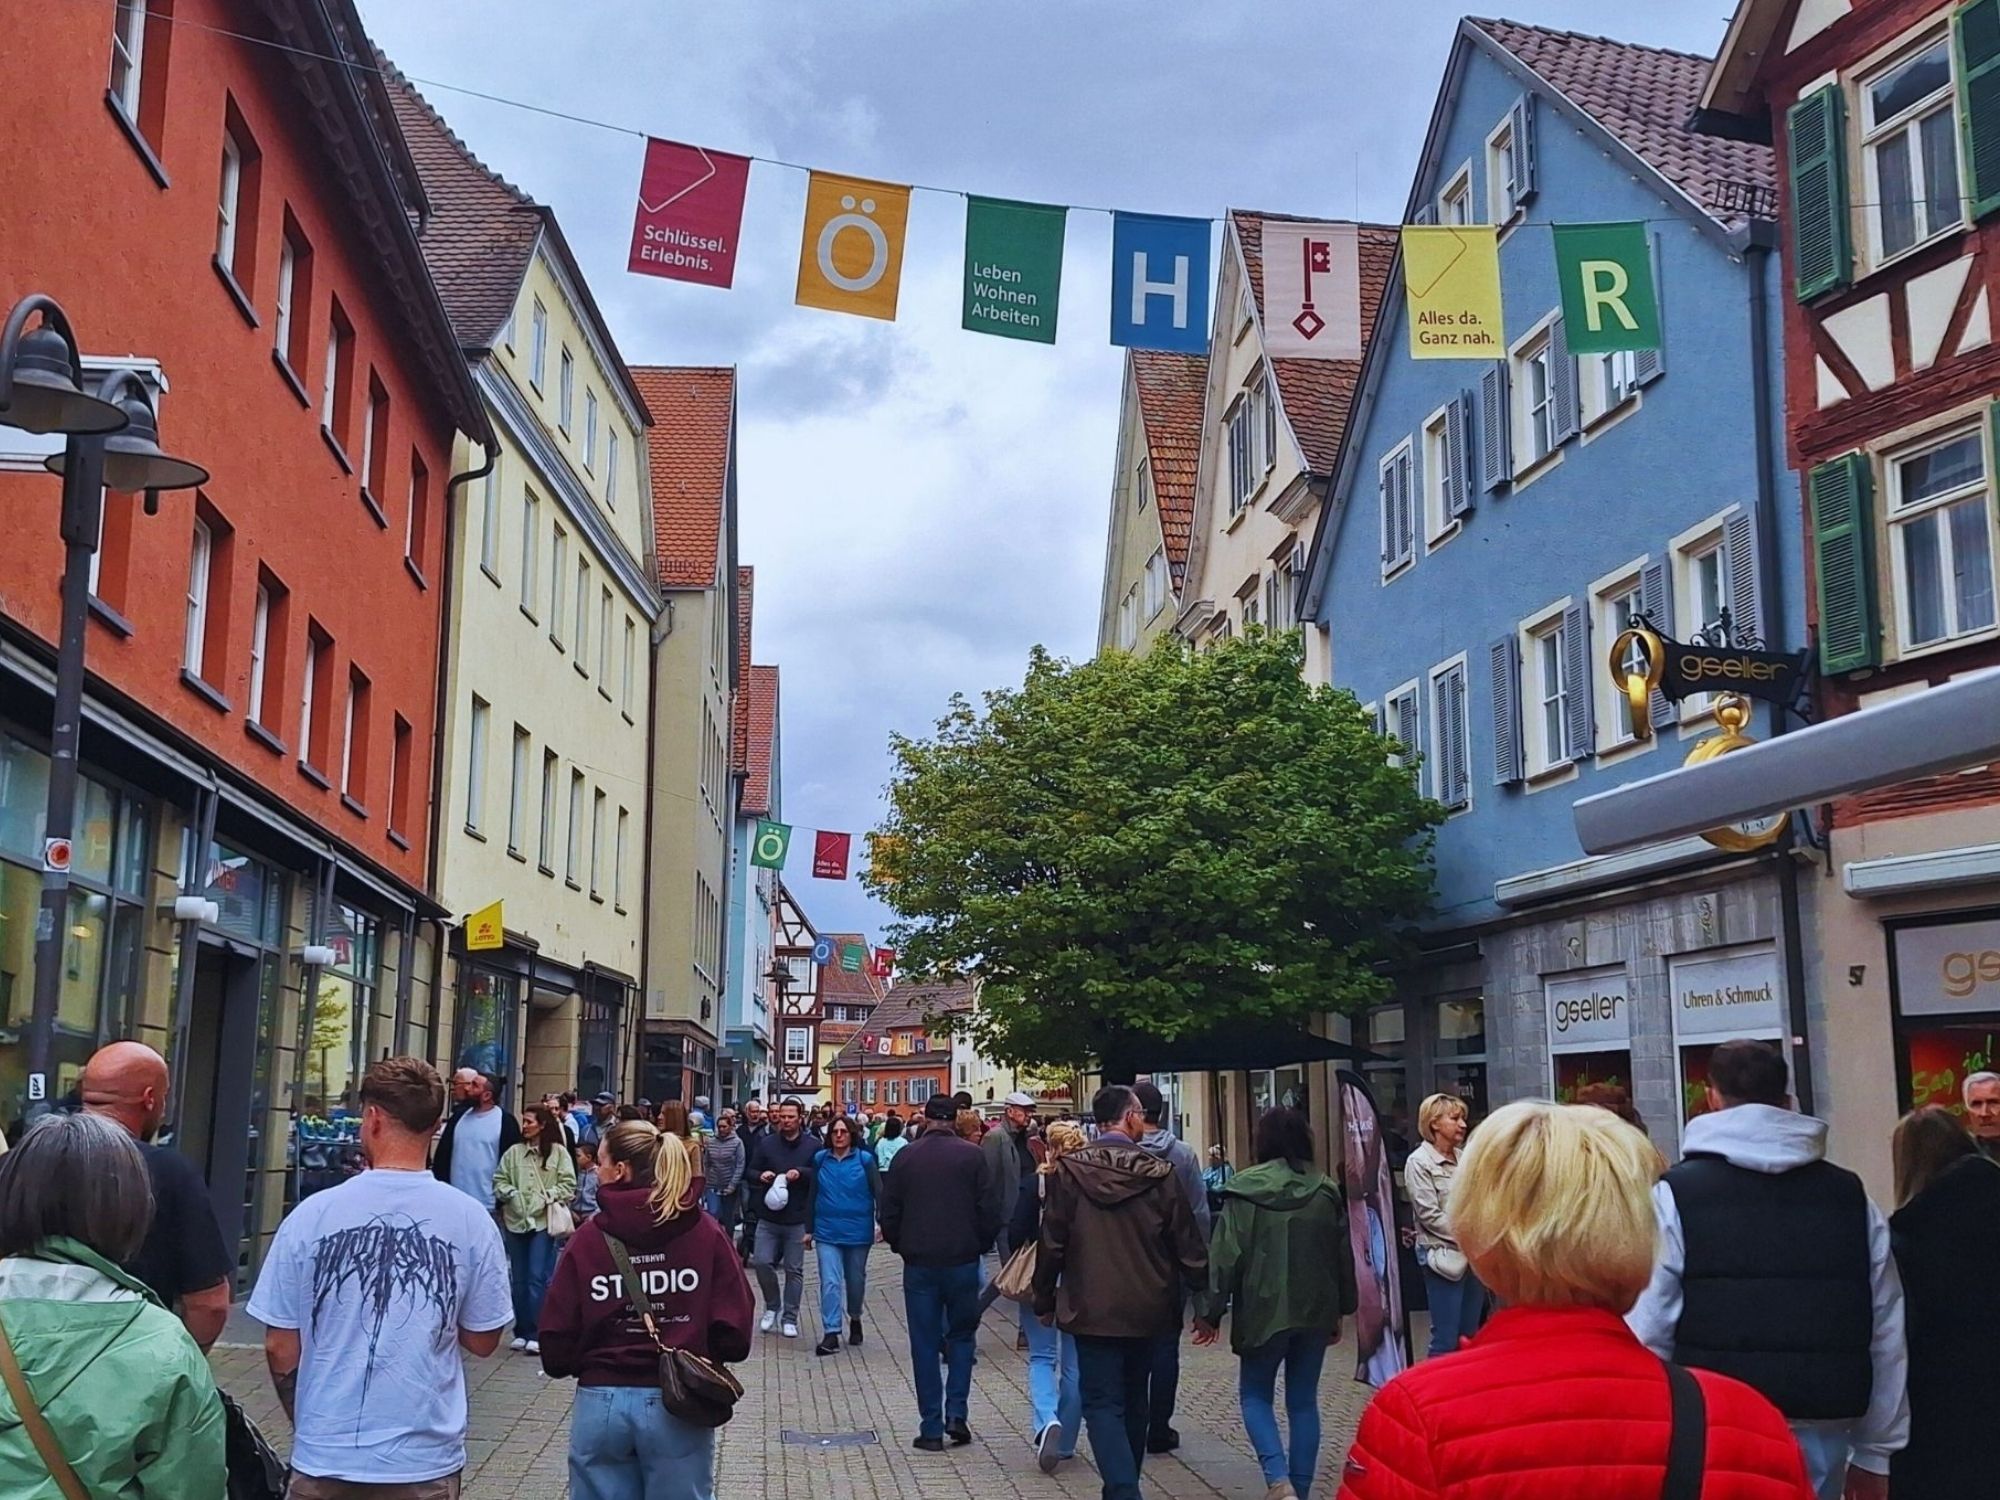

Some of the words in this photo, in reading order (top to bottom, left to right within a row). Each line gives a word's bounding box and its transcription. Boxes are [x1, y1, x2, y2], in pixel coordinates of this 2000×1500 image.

[644, 225, 727, 253] Schlüssel.
[817, 195, 889, 292] Ö
[641, 245, 714, 272] Erlebnis.
[973, 261, 1021, 283] Leben
[972, 281, 1037, 306] Wohnen
[1131, 251, 1190, 329] H
[1579, 260, 1640, 332] R
[971, 302, 1040, 327] Arbeiten
[1418, 310, 1455, 327] Alles
[1458, 310, 1482, 327] da.
[1419, 330, 1459, 346] Ganz
[1463, 330, 1496, 346] nah.
[1679, 654, 1789, 681] gseller
[757, 827, 784, 861] Ö
[1683, 989, 1714, 1009] Uhren
[1715, 988, 1724, 1006] &
[1725, 981, 1773, 1005] Schmuck
[1555, 991, 1625, 1033] gseller
